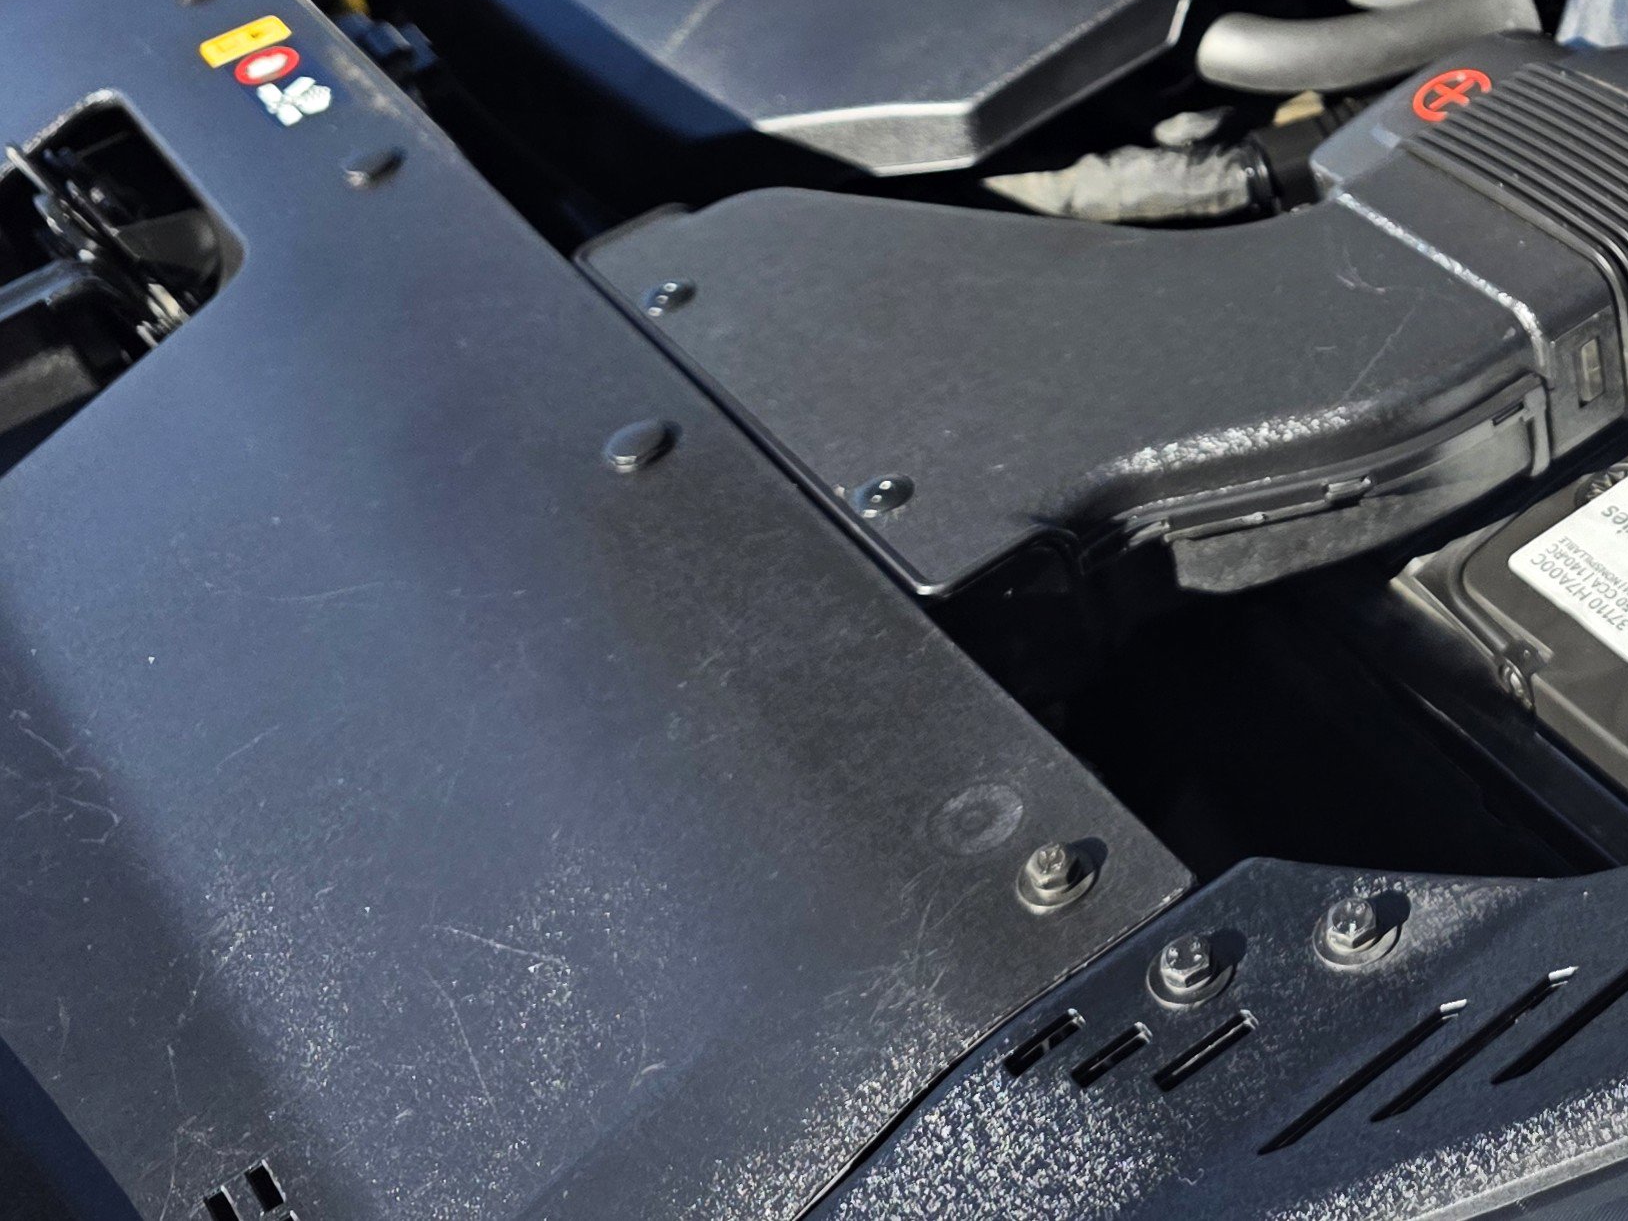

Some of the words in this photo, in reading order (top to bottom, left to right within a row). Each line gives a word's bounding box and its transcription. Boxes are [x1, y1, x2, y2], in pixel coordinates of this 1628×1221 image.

[1545, 543, 1586, 576] 140-RC
[1558, 536, 1621, 585] NONSPILLABLE
[1590, 577, 1617, 599] CCA
